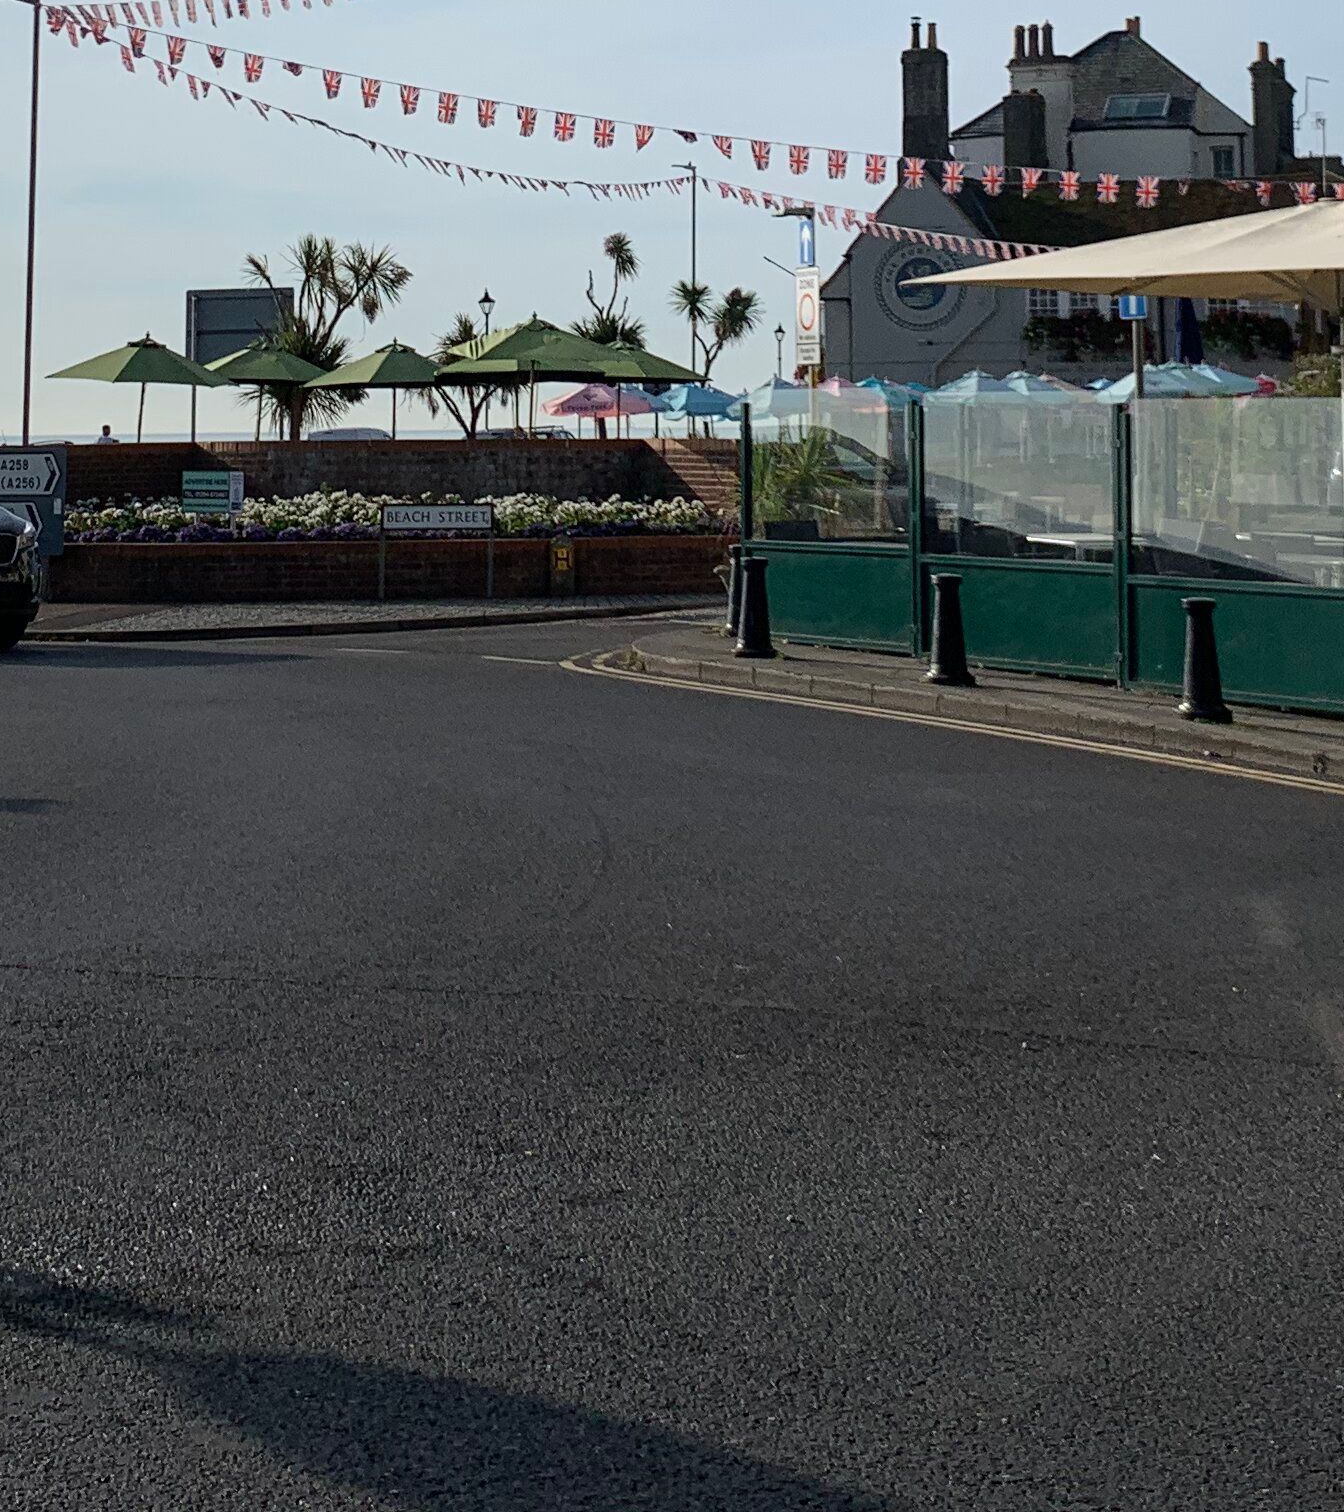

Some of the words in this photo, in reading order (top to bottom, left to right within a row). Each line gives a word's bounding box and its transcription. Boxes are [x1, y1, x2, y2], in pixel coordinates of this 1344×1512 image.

[1, 459, 29, 470] A258
[1, 476, 40, 490] (A256)
[386, 511, 430, 523] BEACH
[439, 510, 487, 523] STREET
[555, 550, 570, 569] H
